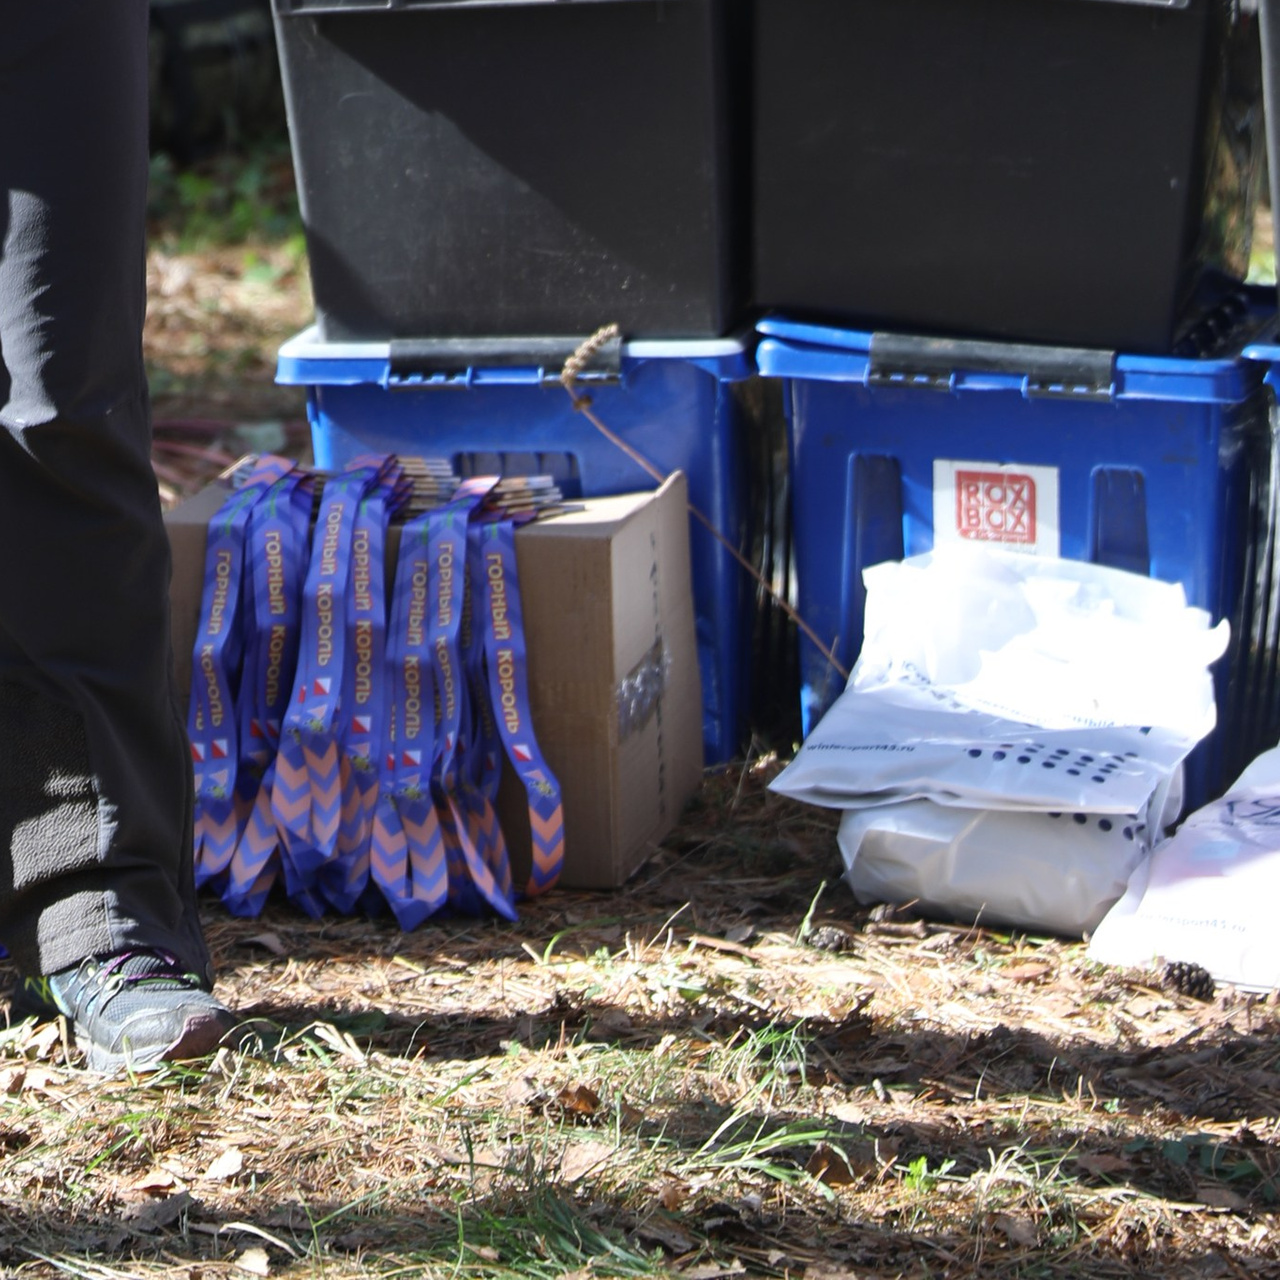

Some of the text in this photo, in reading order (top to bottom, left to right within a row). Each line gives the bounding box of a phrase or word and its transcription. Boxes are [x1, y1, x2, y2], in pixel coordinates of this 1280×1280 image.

[201, 551, 232, 727] ГОРНЫЙ КОРОЛЬ
[265, 530, 286, 707] ГОРНЫЙ КОРОЛЬ
[318, 501, 344, 667] ГОРНЫЙ КОРОЛЬ
[353, 529, 371, 705] ГОРНЫЙ КОРОЛЬ
[404, 560, 427, 739] ГОРНЫЙ КОРОЛЬ
[438, 542, 453, 627] ГОРНЫЙ
[487, 553, 519, 735] ГОРНЫЙ КОРОЛЬ
[436, 635, 455, 720] КОРОЛЬ
